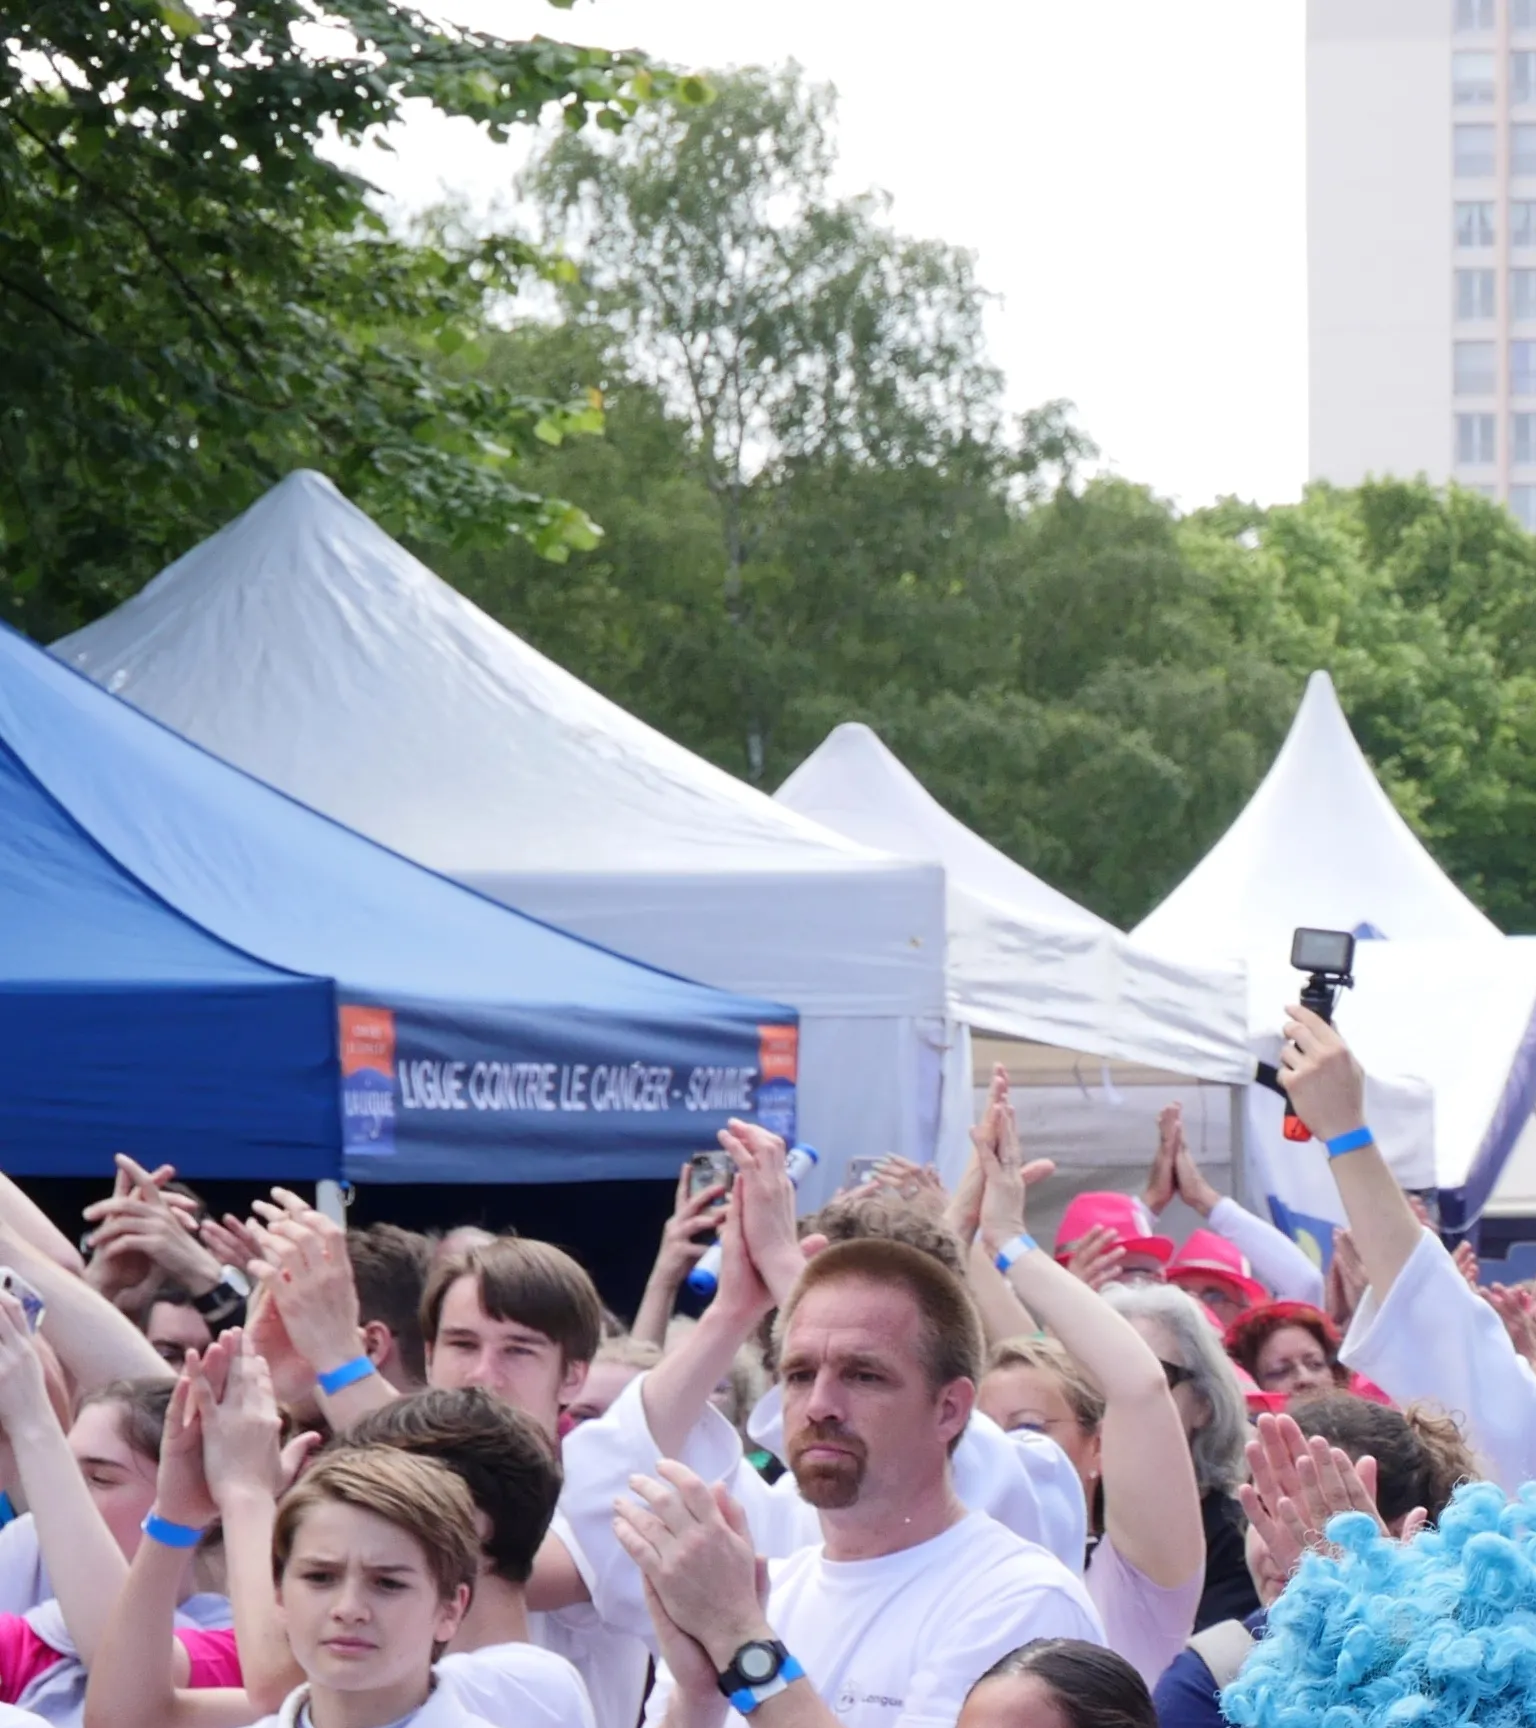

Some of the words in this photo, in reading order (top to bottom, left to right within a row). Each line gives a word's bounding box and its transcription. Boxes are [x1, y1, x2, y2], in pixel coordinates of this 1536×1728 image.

[398, 1059, 468, 1110] LIGUE
[468, 1061, 557, 1111] CONTRE
[561, 1064, 589, 1111] LE
[590, 1061, 672, 1111] CANCER
[685, 1066, 757, 1112] SOMME
